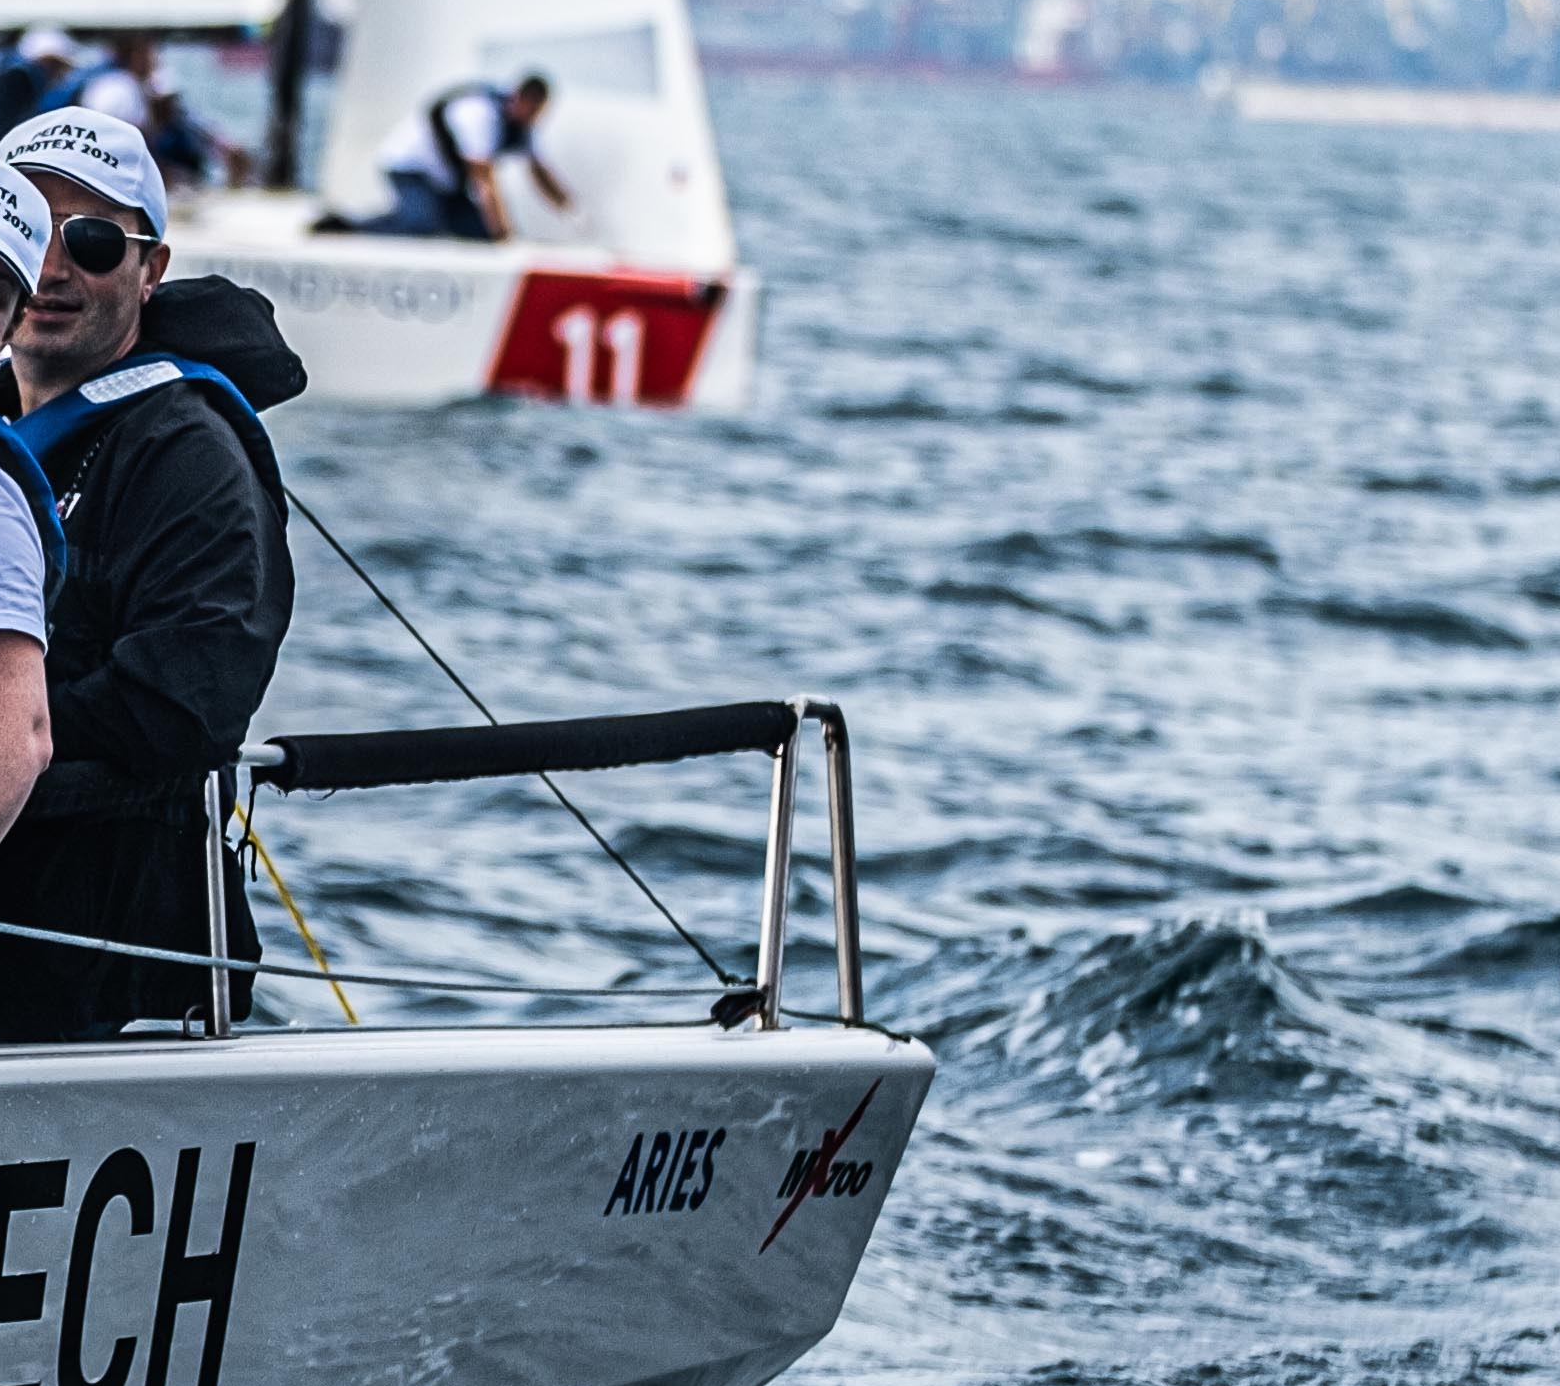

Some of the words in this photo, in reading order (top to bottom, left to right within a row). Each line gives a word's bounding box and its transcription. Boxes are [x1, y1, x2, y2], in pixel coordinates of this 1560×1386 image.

[80, 143, 120, 169] 2022
[3, 209, 32, 241] 2022
[549, 304, 647, 410] 11
[602, 1126, 728, 1217] ARIES
